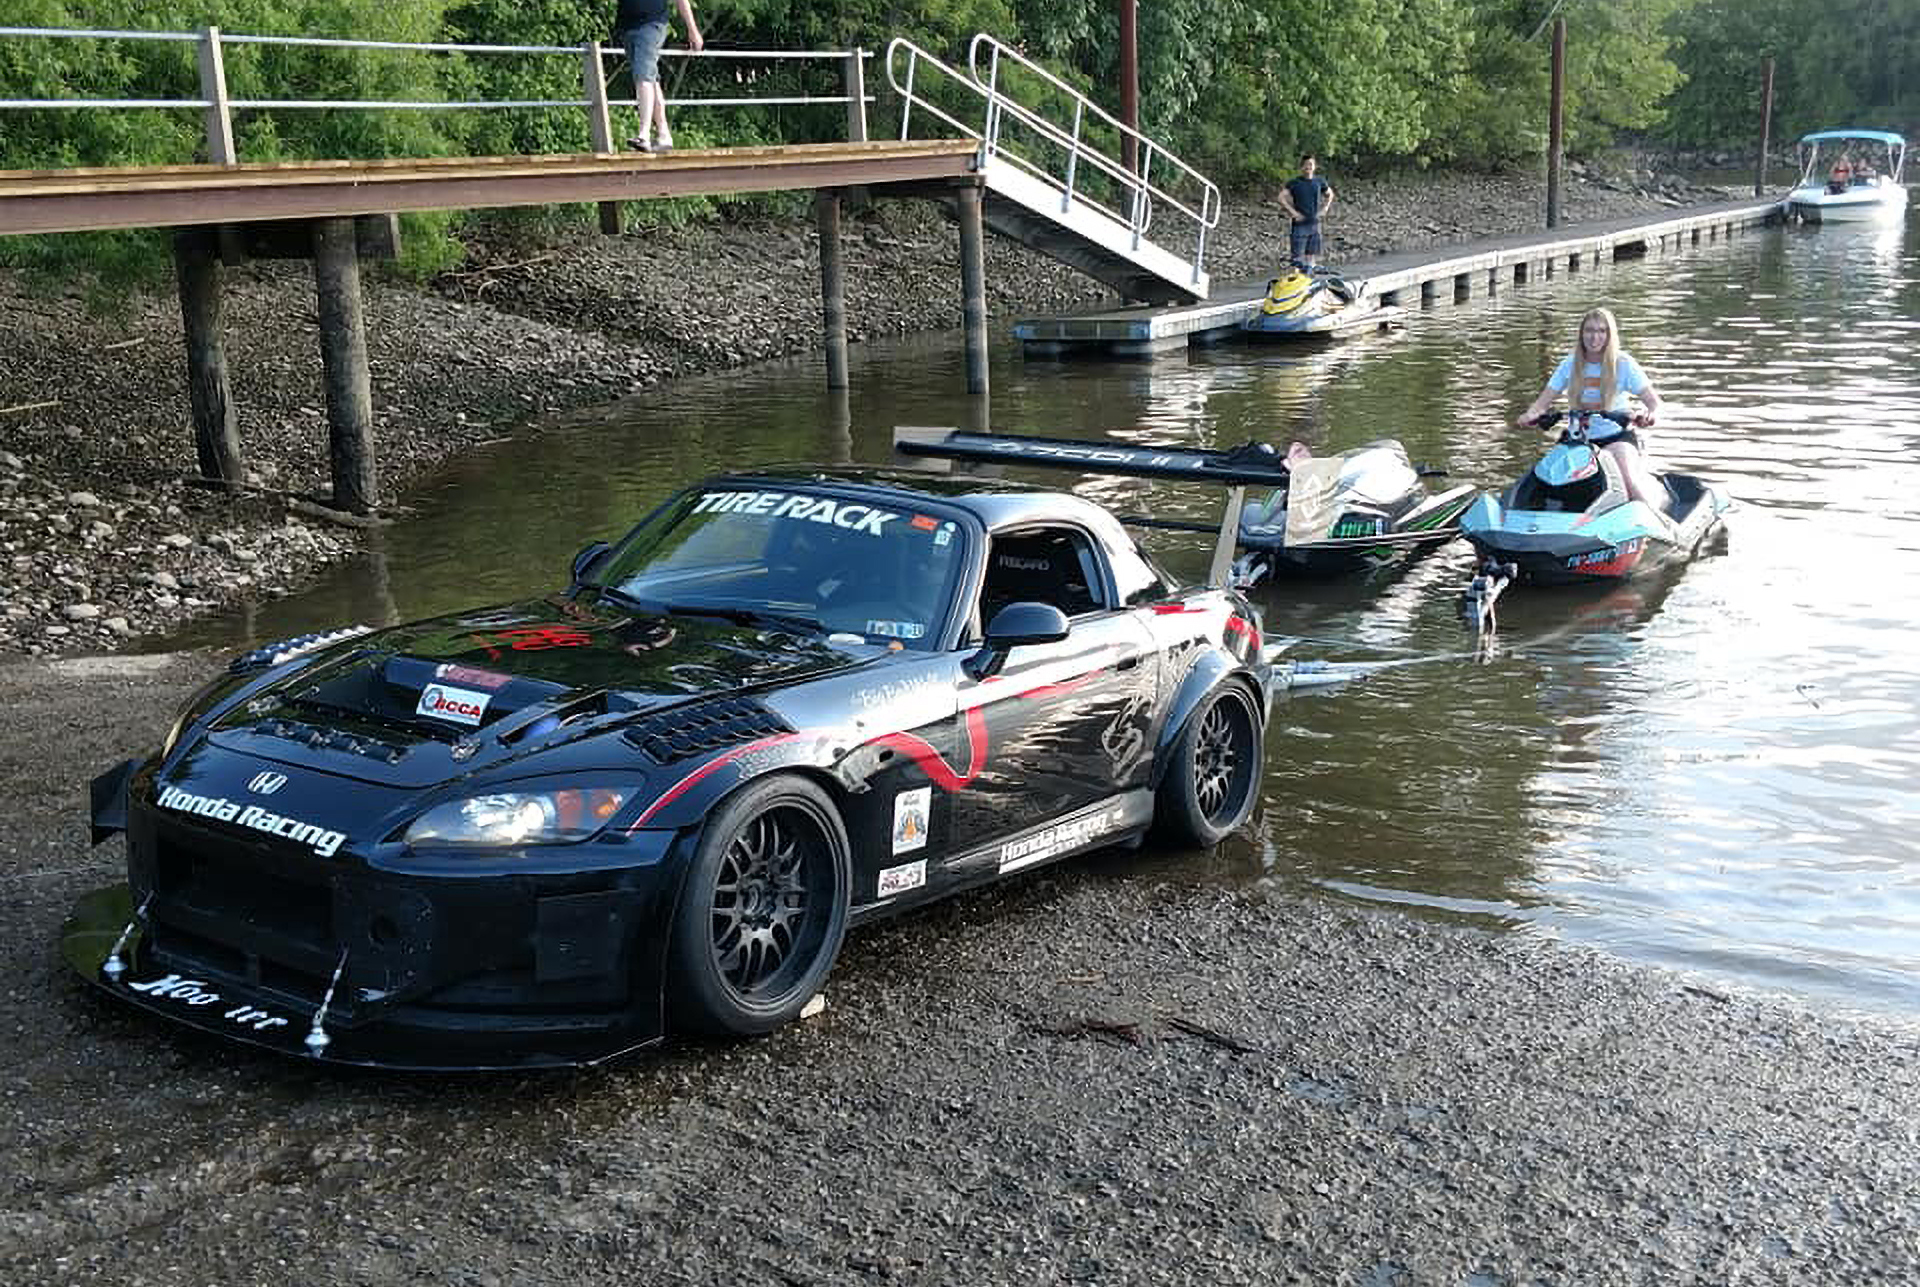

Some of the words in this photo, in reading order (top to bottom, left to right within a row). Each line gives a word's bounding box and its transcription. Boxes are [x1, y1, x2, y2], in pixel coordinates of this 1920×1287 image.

[691, 492, 786, 514] TIRE
[773, 496, 900, 536] RACK
[157, 785, 241, 822] Honda
[236, 805, 347, 858] Racing
